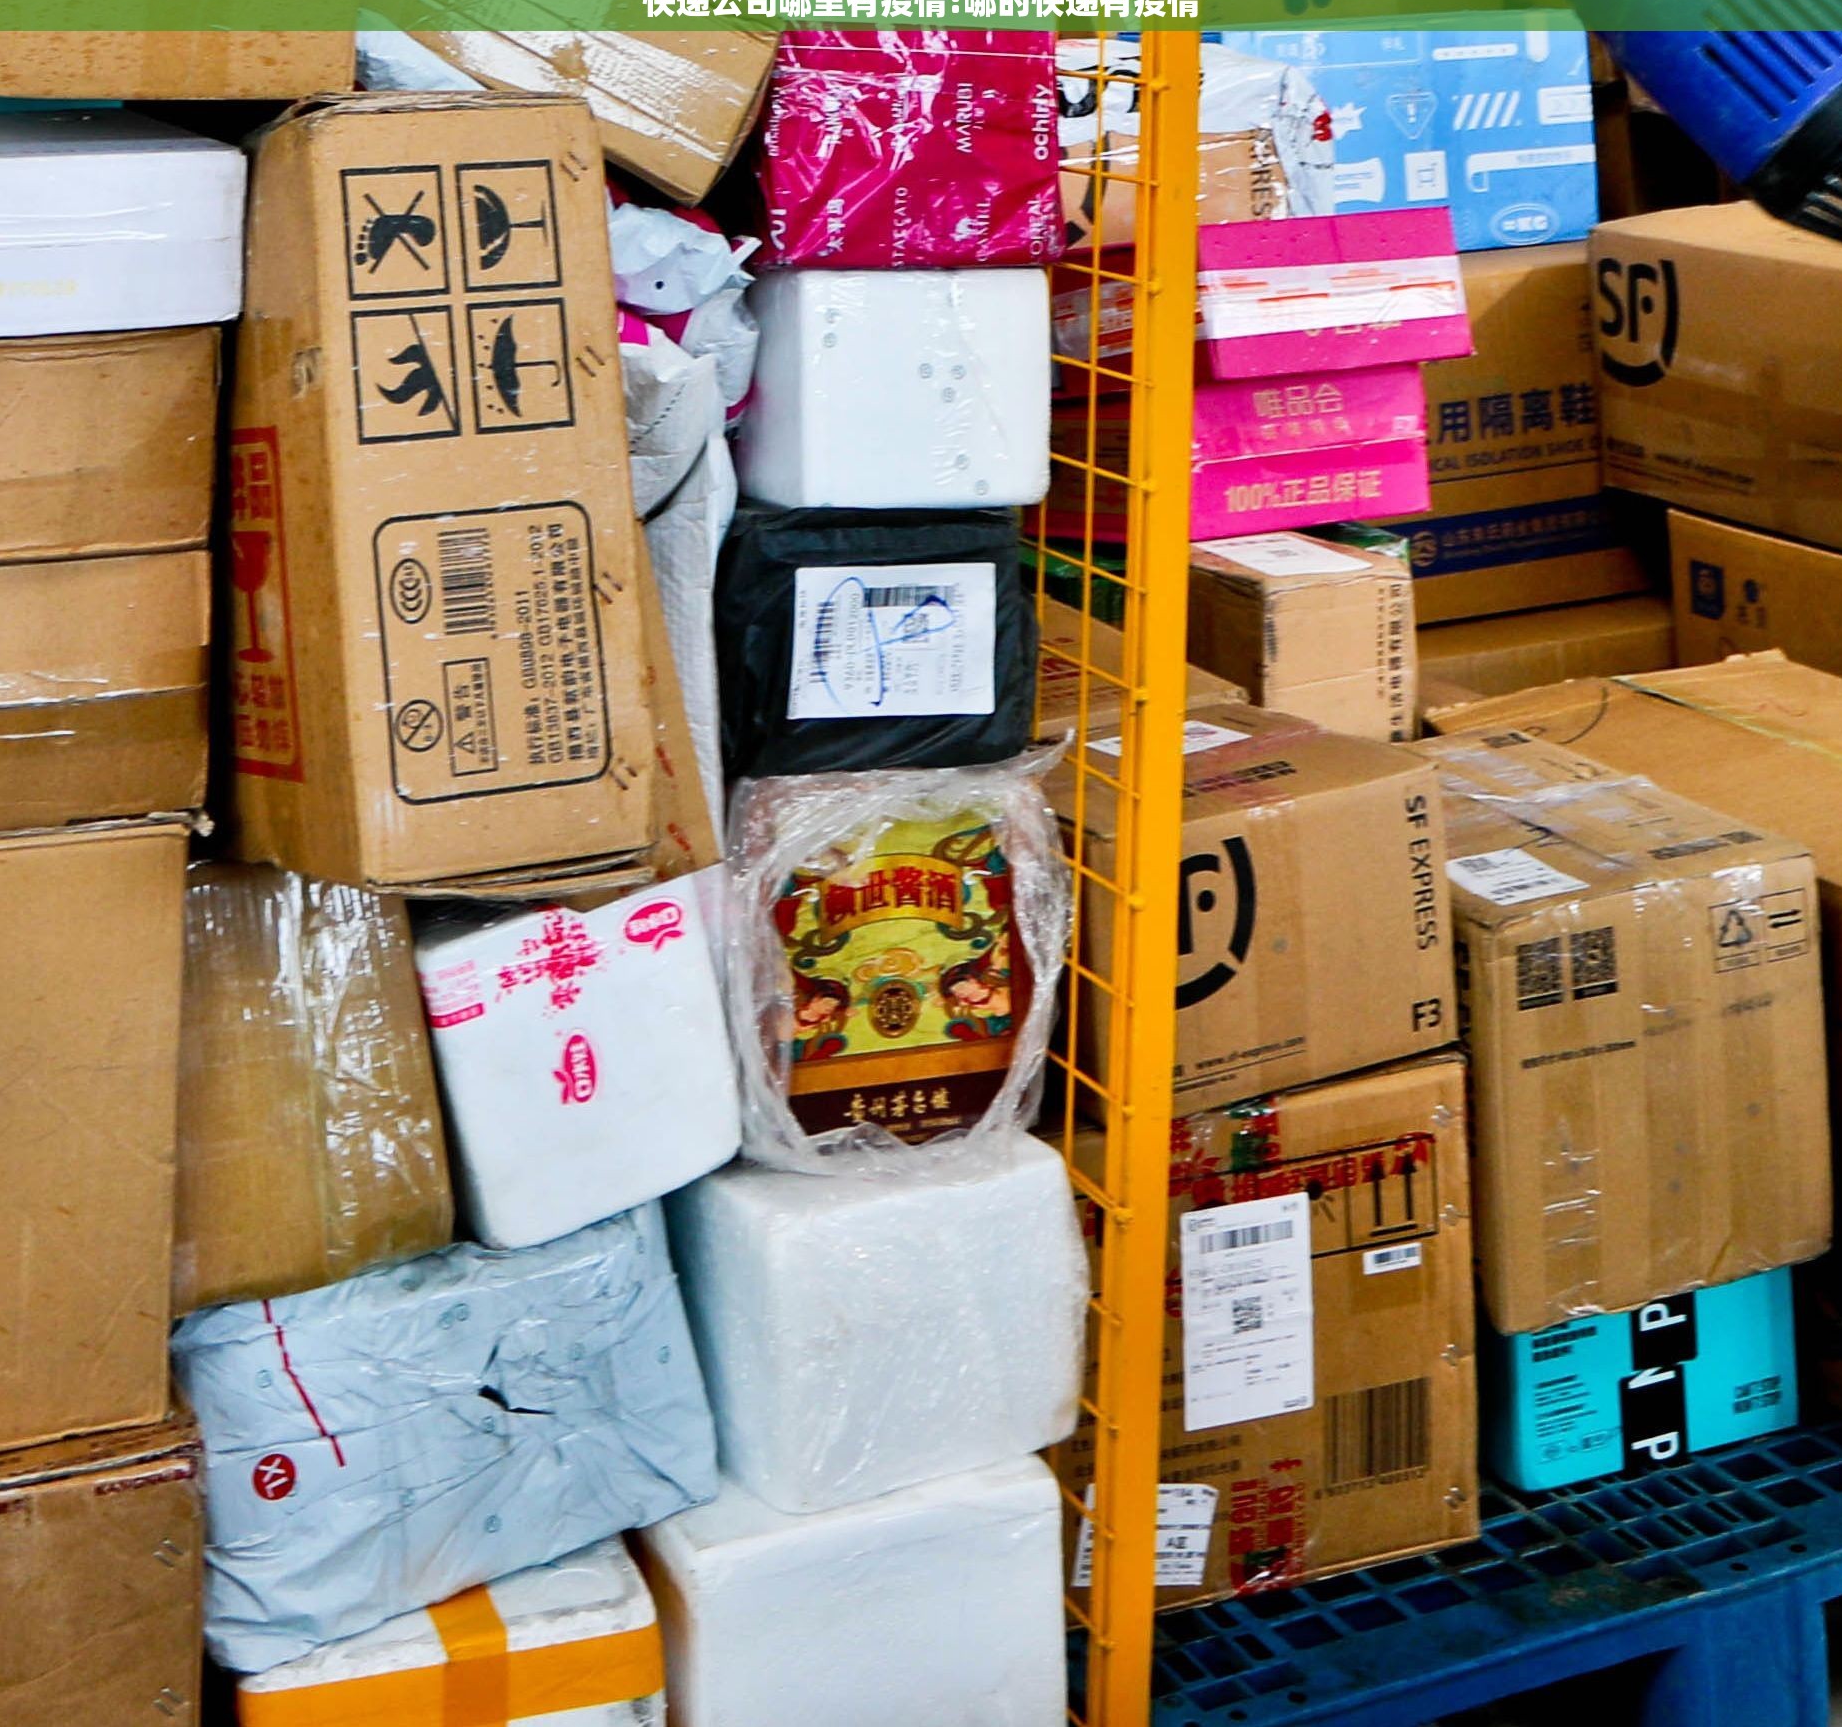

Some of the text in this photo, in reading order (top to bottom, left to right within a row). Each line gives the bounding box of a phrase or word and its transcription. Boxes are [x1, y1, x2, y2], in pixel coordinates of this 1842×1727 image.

[956, 82, 973, 154] MARUBI
[1031, 83, 1053, 161] ochirly
[1253, 383, 1344, 419] 唯品会
[1223, 469, 1383, 514] 100%正品保证
[1404, 794, 1439, 951] SF EXPRESS
[1412, 997, 1443, 1033] F3
